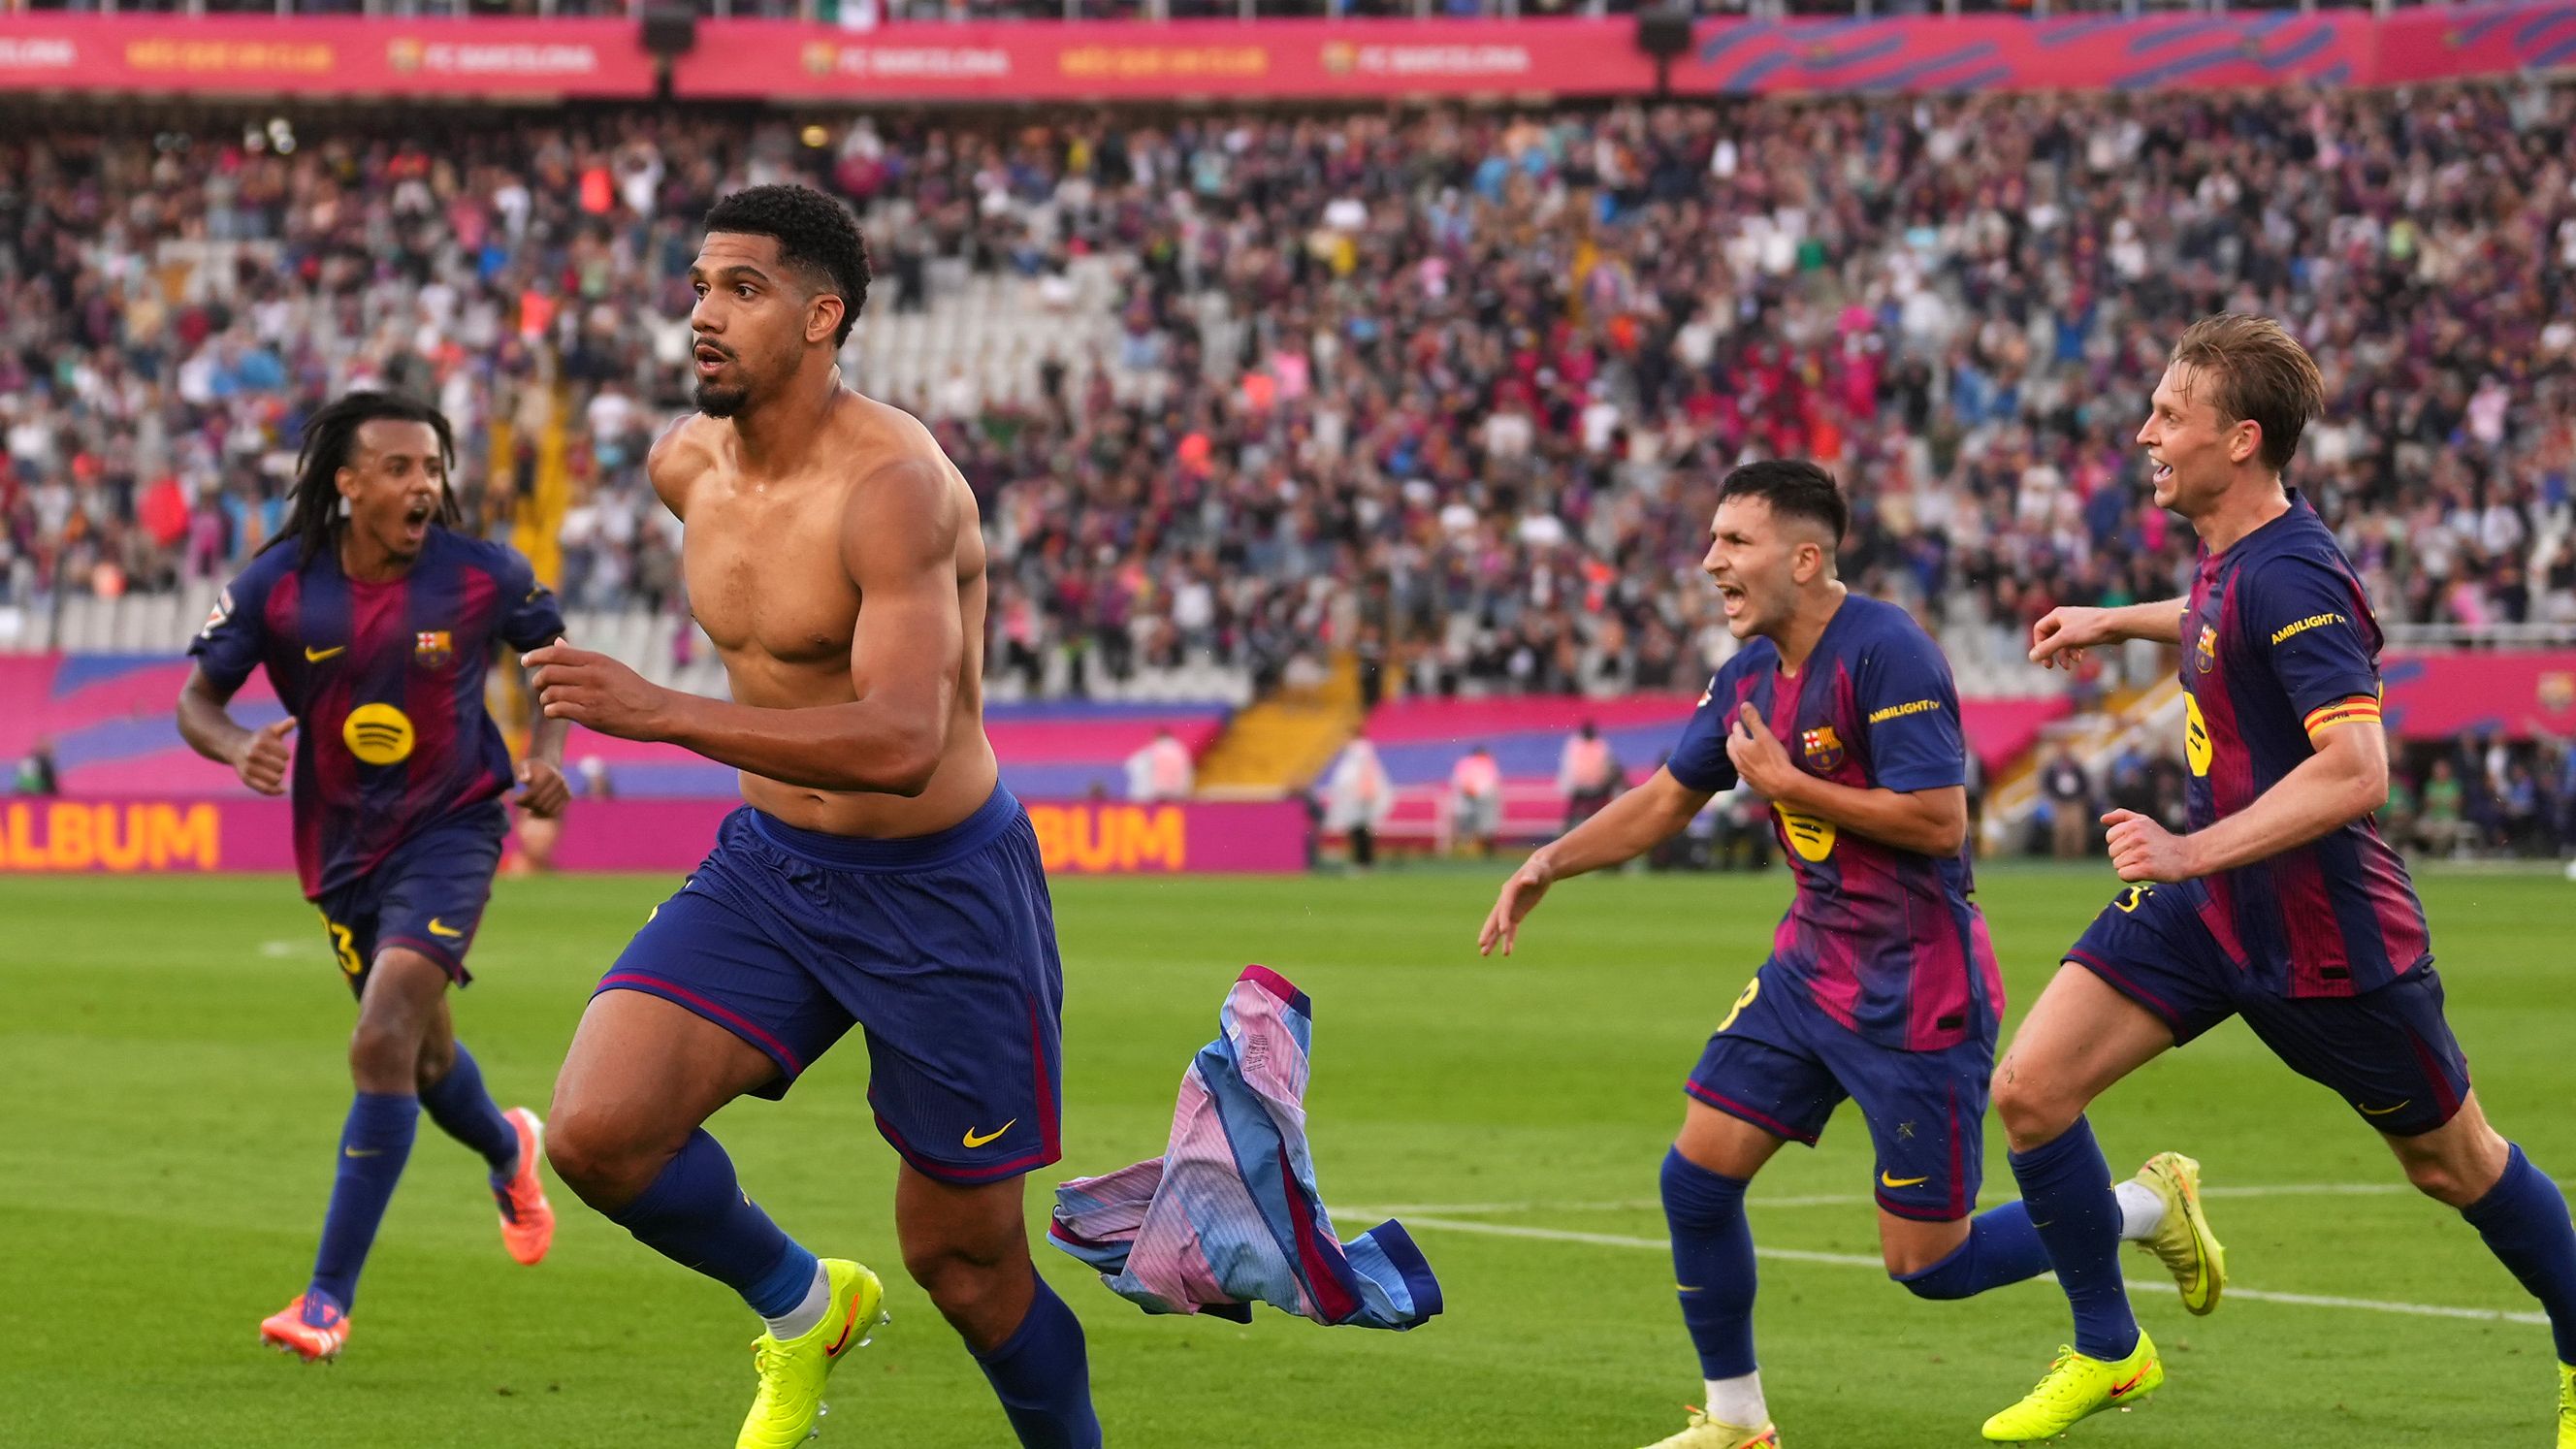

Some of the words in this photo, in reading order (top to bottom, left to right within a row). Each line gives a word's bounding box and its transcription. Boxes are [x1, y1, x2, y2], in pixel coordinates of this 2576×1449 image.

[2270, 613, 2334, 646] AMBILIGHT
[1869, 699, 1929, 724] AMBILIGHT
[0, 802, 218, 871] LBUM
